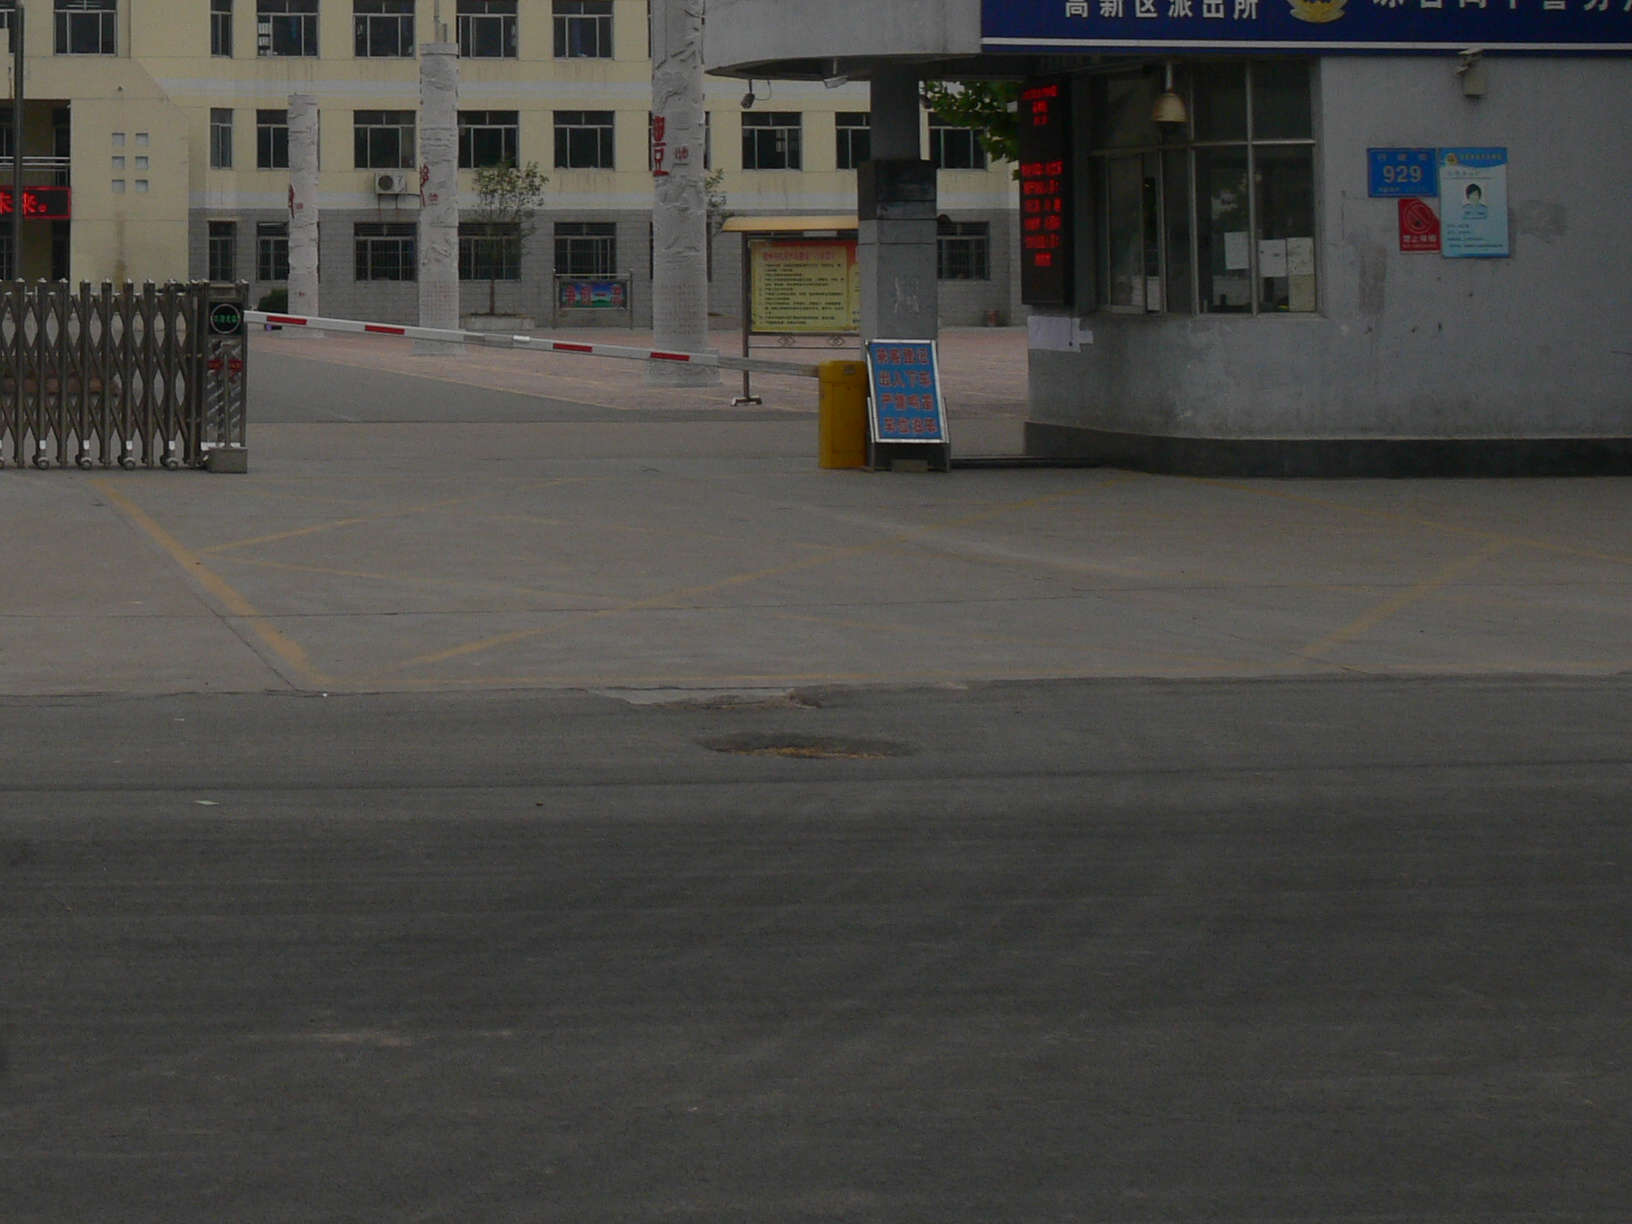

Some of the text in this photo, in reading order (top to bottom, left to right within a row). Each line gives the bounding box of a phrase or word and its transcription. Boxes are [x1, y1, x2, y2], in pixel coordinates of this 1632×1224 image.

[1382, 164, 1424, 184] 929
[878, 370, 933, 388] 出入下车
